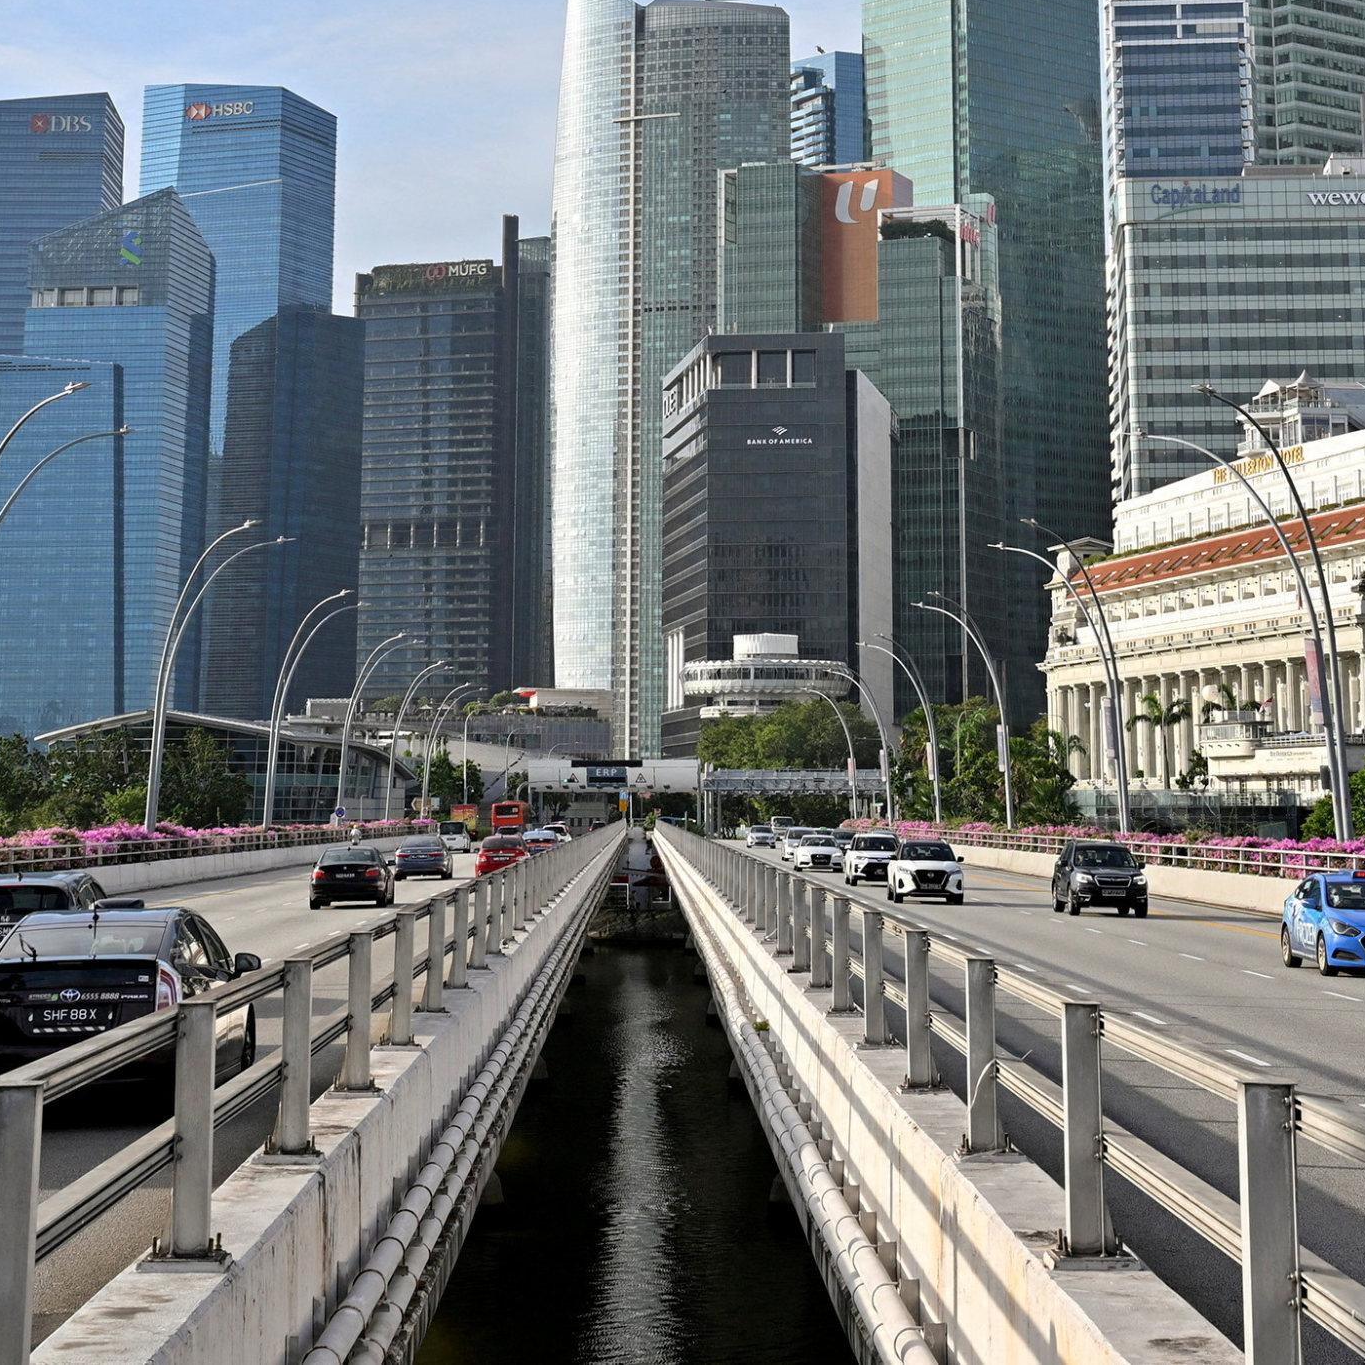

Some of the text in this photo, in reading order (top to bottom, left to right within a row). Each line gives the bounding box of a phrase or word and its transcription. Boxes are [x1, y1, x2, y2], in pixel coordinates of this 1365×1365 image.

[212, 101, 254, 117] HSBC
[50, 115, 92, 133] DBS
[1150, 181, 1242, 210] CapitaLand
[448, 263, 488, 276] MUFG
[1212, 467, 1227, 484] THE
[595, 769, 618, 777] ERP
[81, 992, 99, 1000] 6555
